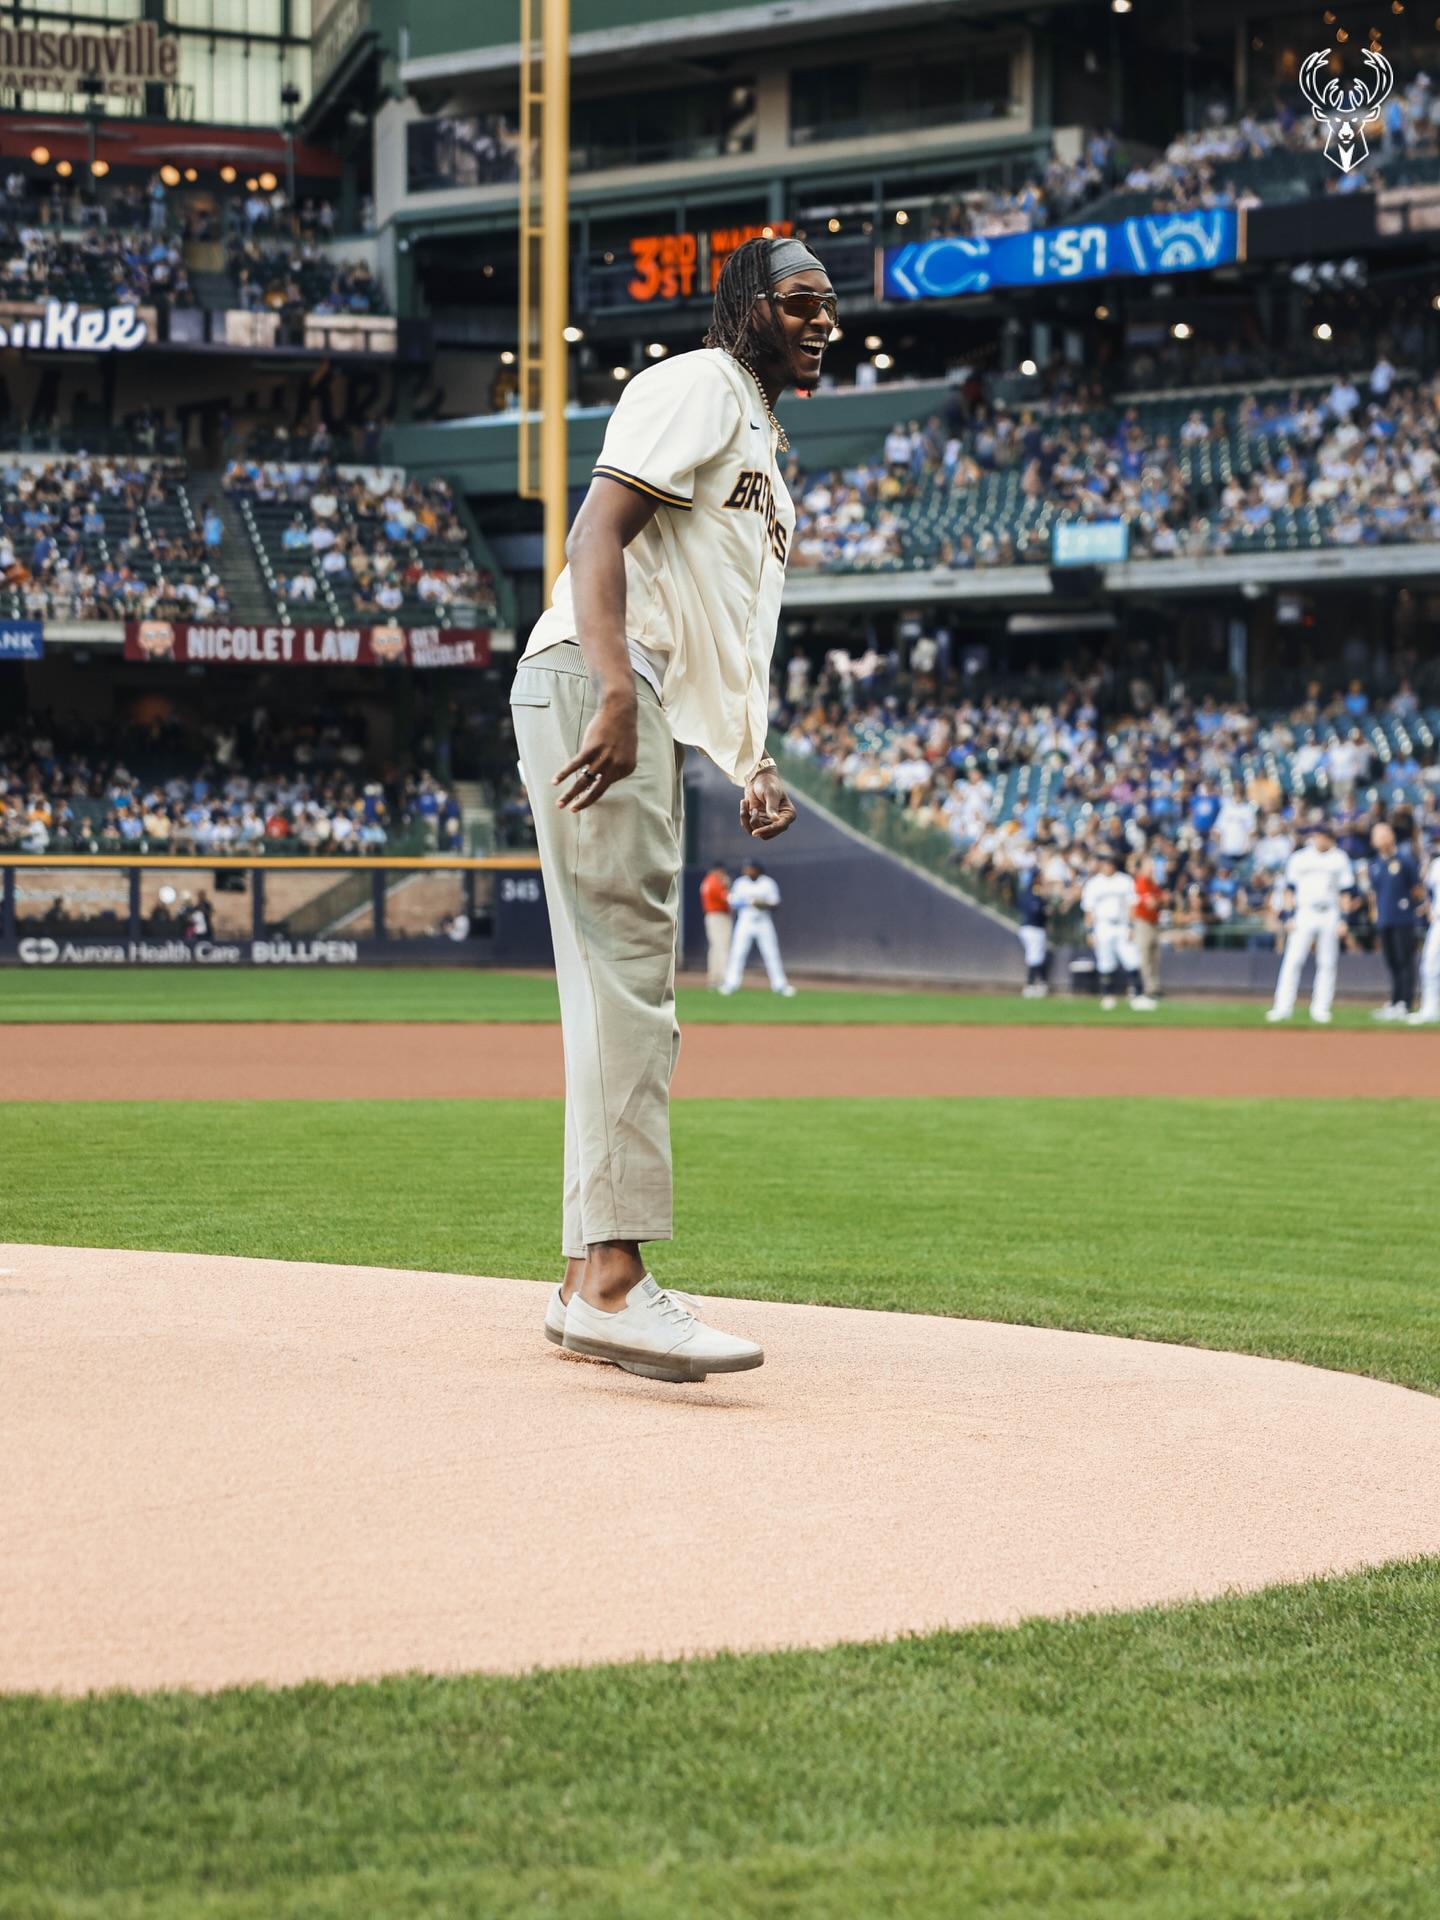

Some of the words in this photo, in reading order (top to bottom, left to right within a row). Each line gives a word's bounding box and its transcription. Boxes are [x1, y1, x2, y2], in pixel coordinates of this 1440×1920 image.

[0, 72, 66, 91] ARTY
[0, 630, 35, 650] NK
[187, 627, 297, 661] NICOLET
[304, 628, 360, 662] LAW
[60, 941, 124, 963] Aurora
[128, 940, 191, 963] Health
[194, 940, 240, 963] Care
[251, 940, 358, 963] BULLPEN
